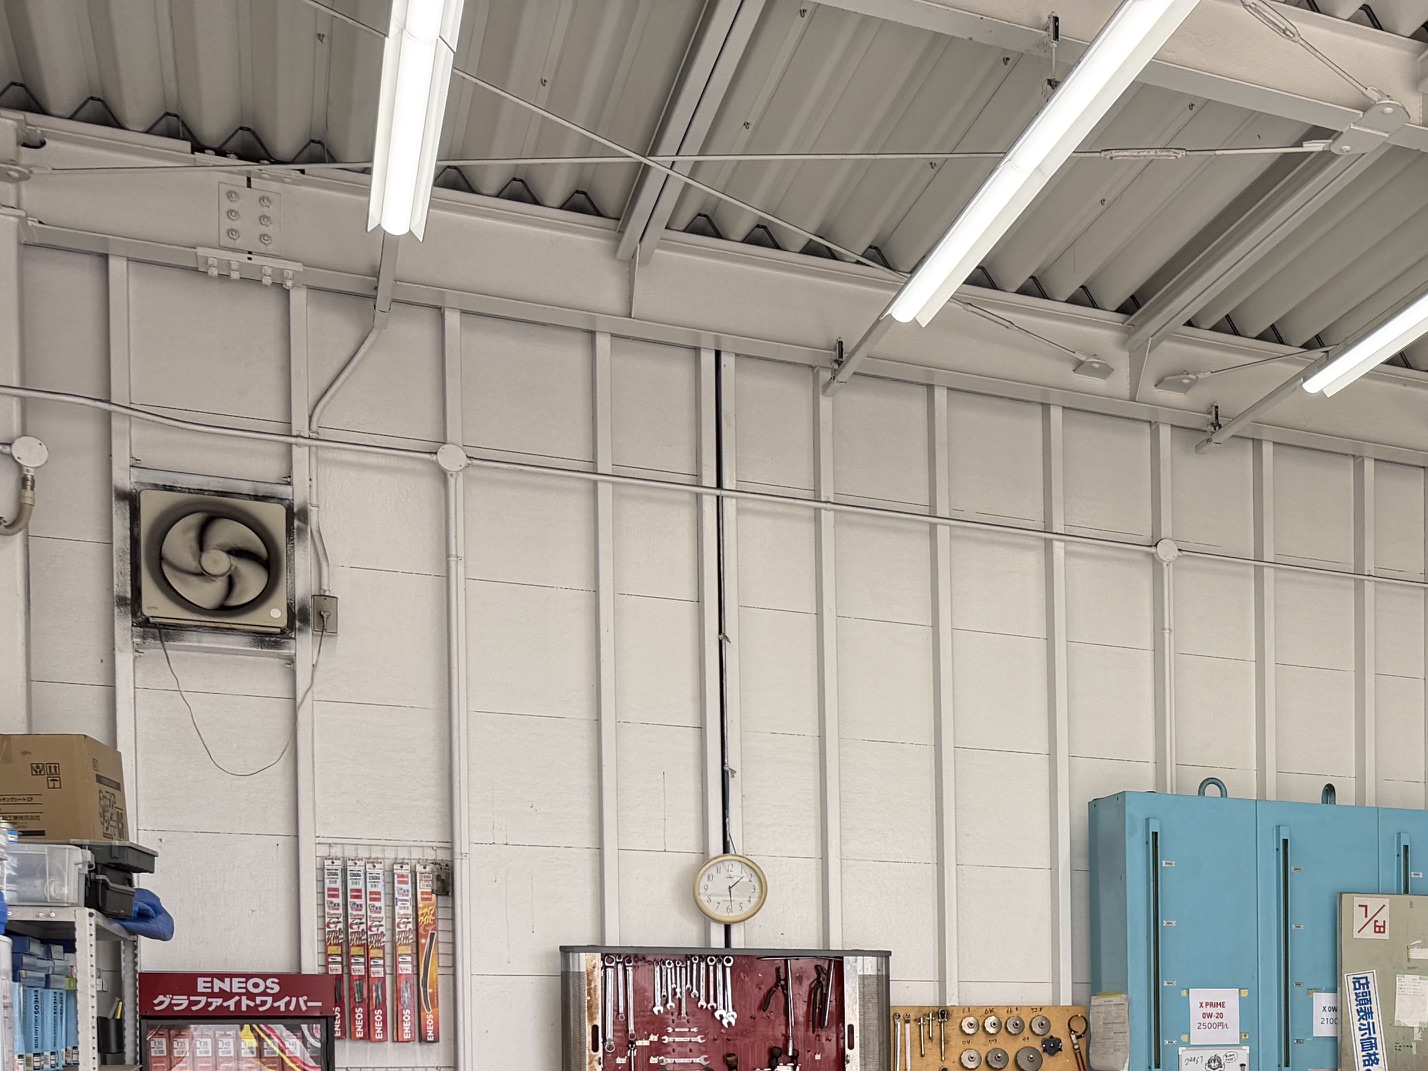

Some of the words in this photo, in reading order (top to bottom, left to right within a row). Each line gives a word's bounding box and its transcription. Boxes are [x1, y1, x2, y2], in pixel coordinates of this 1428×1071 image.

[197, 977, 280, 993] ENEOS
[153, 995, 323, 1012] グラファイトワイパー
[1205, 1001, 1226, 1009] PRIME
[356, 1007, 364, 1038] ENEOS
[375, 1009, 383, 1039] ENEOS
[403, 1009, 411, 1039] ENEOS
